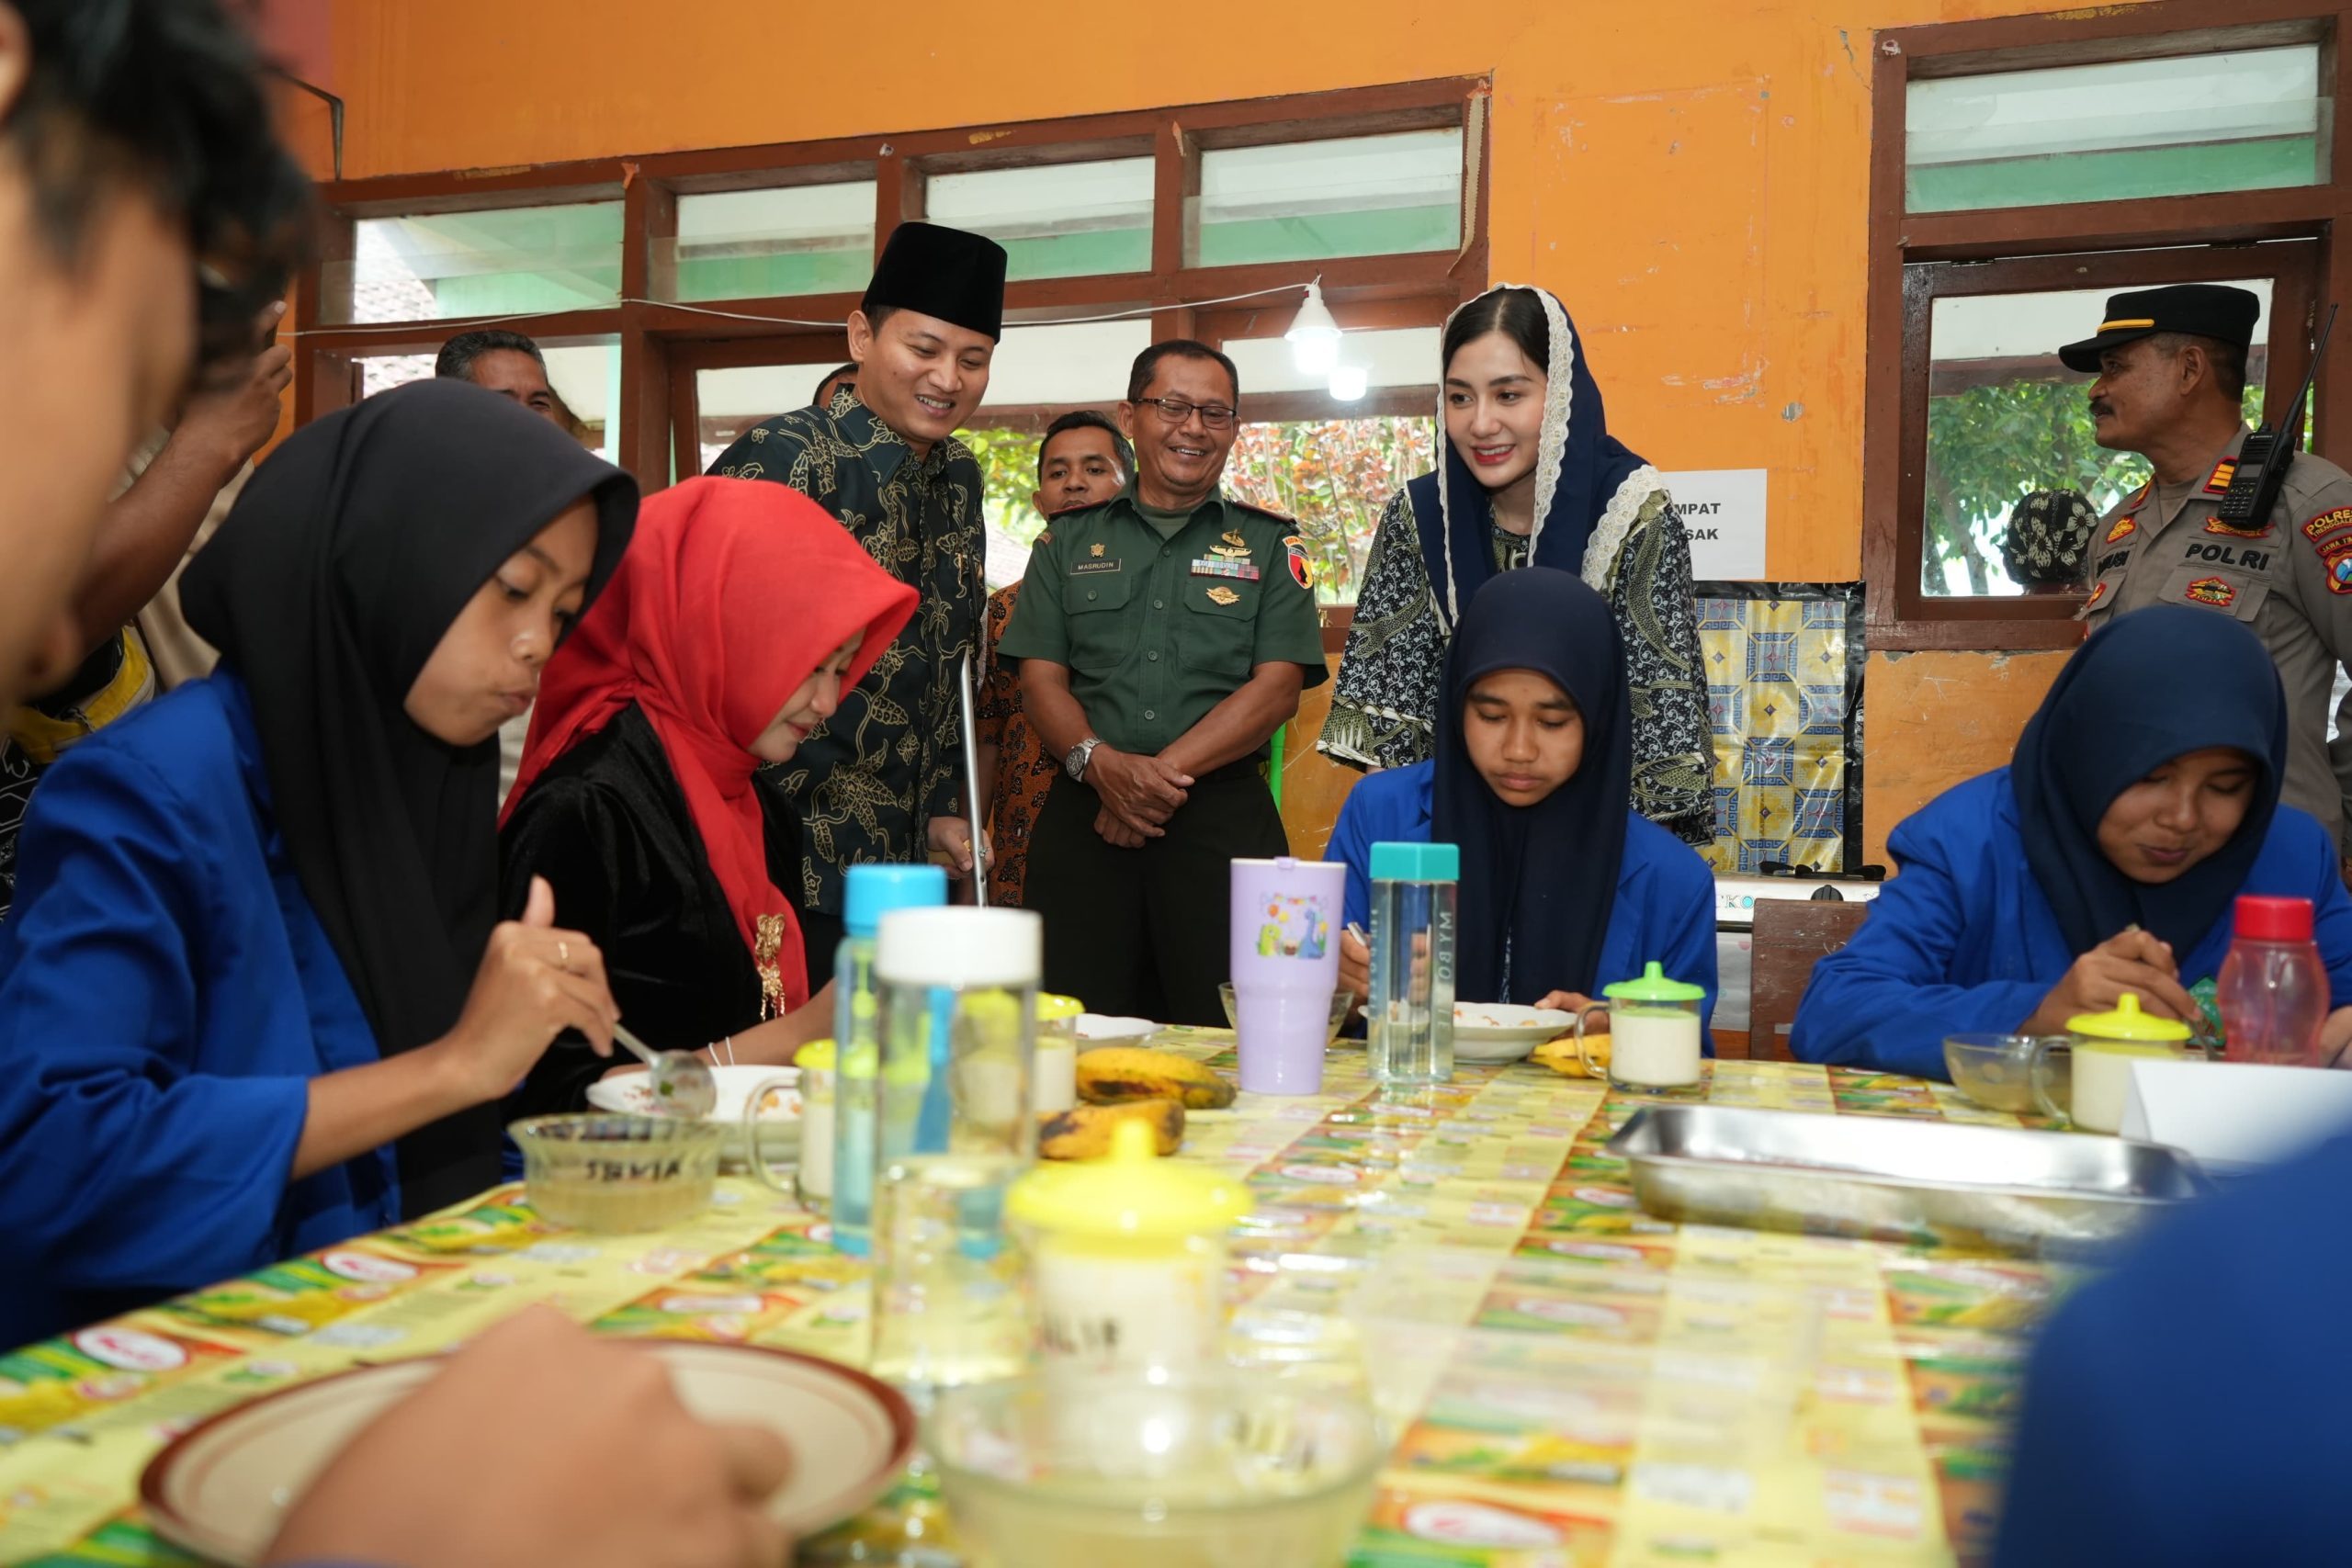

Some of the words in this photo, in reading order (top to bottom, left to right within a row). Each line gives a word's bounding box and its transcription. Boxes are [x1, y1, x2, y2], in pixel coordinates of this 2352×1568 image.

[2306, 509, 2352, 536] POLRE
[1078, 561, 1114, 570] MASRUDIN
[2185, 543, 2270, 571] POLRI
